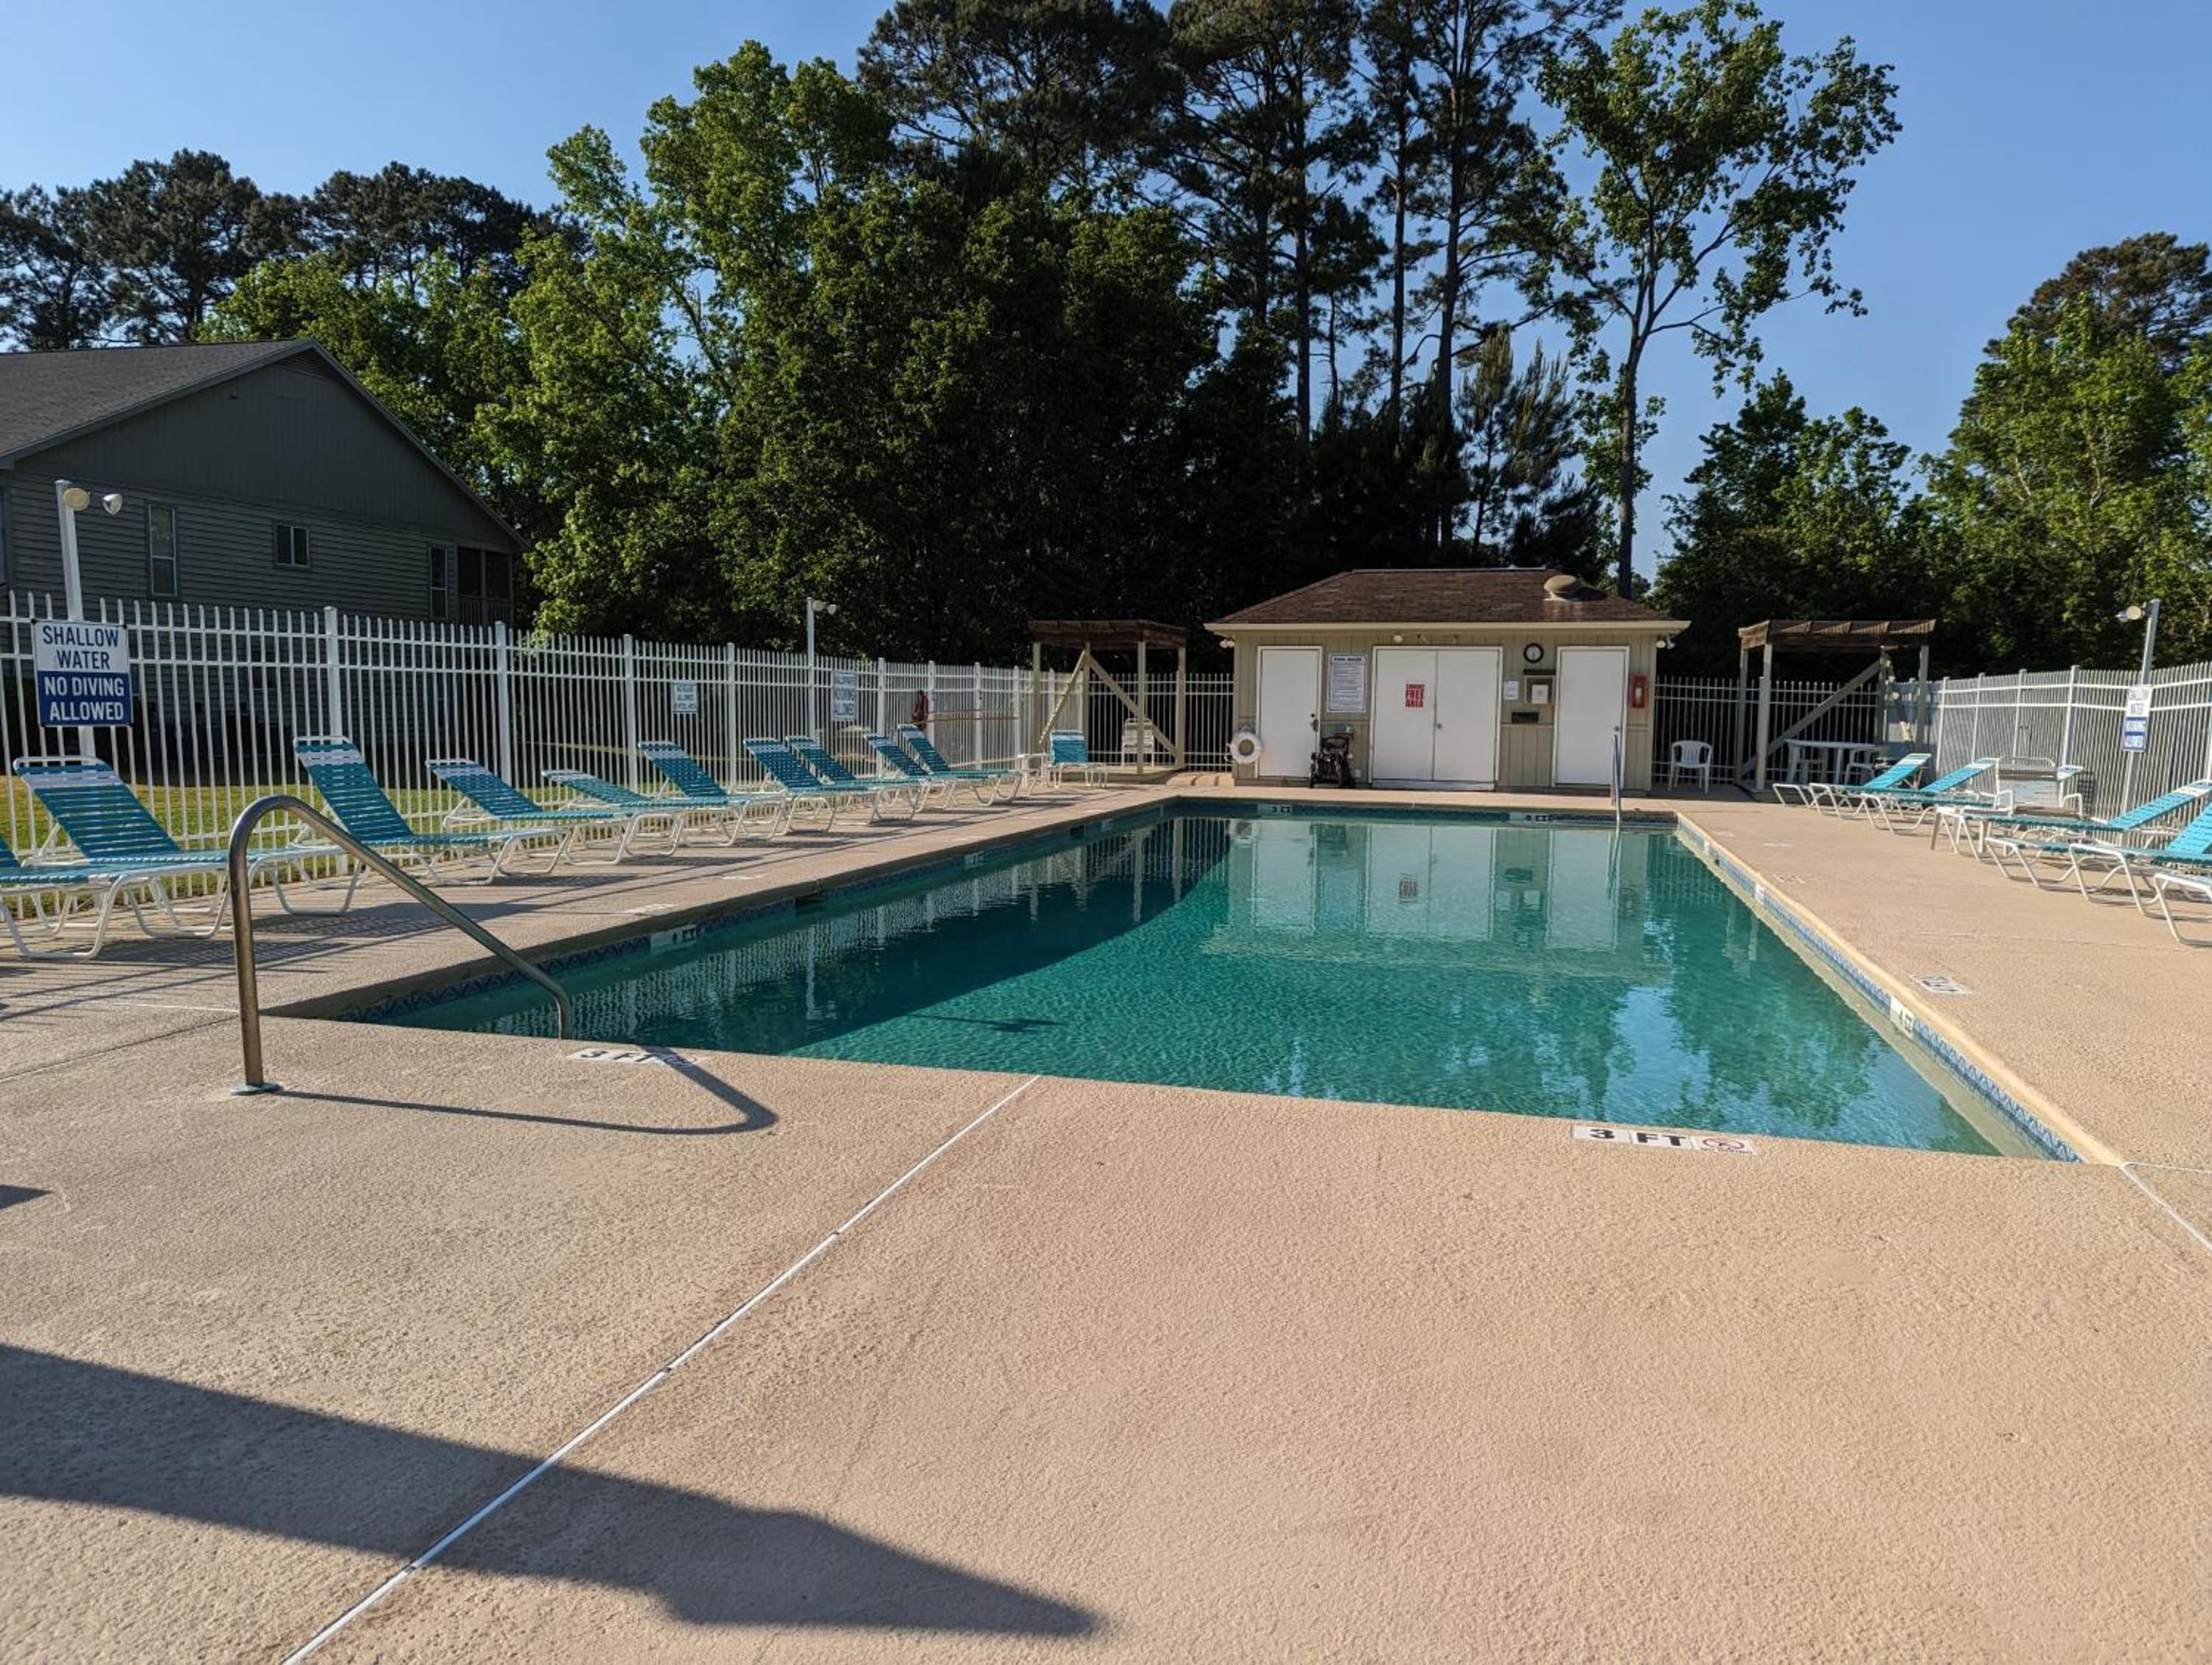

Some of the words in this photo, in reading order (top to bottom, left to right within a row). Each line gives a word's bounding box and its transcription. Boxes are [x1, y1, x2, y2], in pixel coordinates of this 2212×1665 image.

[43, 625, 119, 647] SHALLOW
[57, 650, 110, 670] WATER
[44, 676, 67, 696] NO
[73, 677, 125, 696] DIVING
[1405, 689, 1424, 699] FREE
[49, 701, 124, 720] ALLOWED
[580, 1050, 608, 1058] 3
[613, 1052, 656, 1063] FT
[1590, 1129, 1615, 1139] 3
[1636, 1132, 1686, 1147] FT
